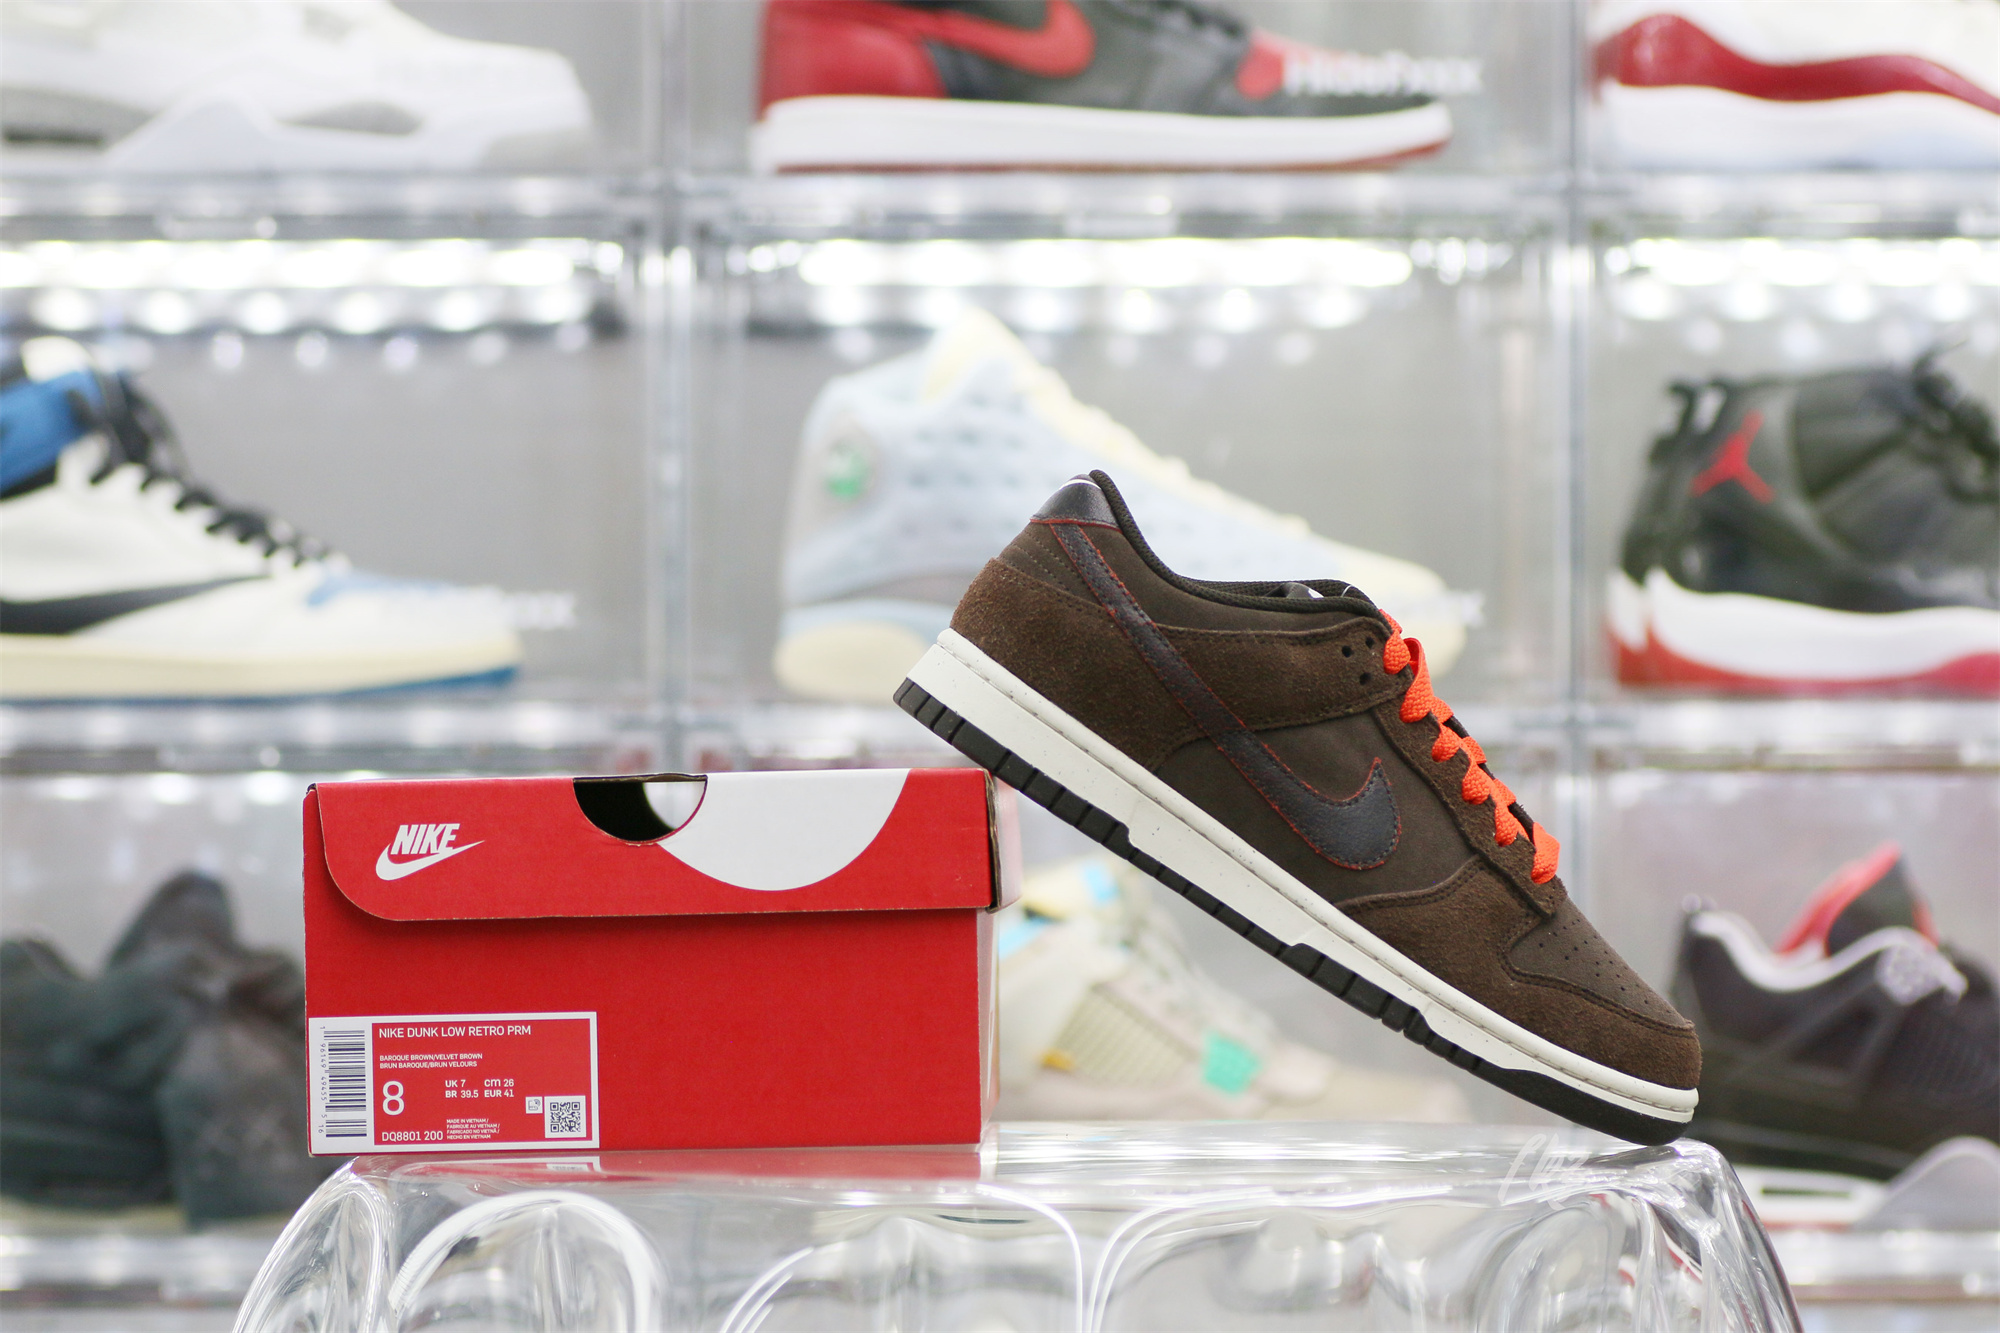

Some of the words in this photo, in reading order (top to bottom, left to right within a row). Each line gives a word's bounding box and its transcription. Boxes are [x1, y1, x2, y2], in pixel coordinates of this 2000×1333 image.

[390, 823, 460, 855] NIKE
[378, 1028, 404, 1038] NIKE
[407, 1027, 439, 1037] DUNK
[441, 1026, 466, 1036] LOW
[468, 1025, 505, 1036] RETRO
[507, 1025, 531, 1035] PRM
[410, 1053, 458, 1061] BROWN/VELVET
[398, 1061, 448, 1069] BAROQUE/BRUN
[448, 1060, 478, 1068] VELOURS
[445, 1080, 458, 1088] UK
[460, 1079, 466, 1087] 7
[484, 1079, 501, 1087] cm
[503, 1079, 515, 1087] 26
[382, 1080, 405, 1116] 8
[445, 1090, 458, 1098] BR
[460, 1089, 479, 1098] 39.5
[484, 1089, 502, 1098] EUR
[503, 1089, 515, 1098] 41
[382, 1131, 421, 1142] DQ8801
[424, 1131, 443, 1141] 200
